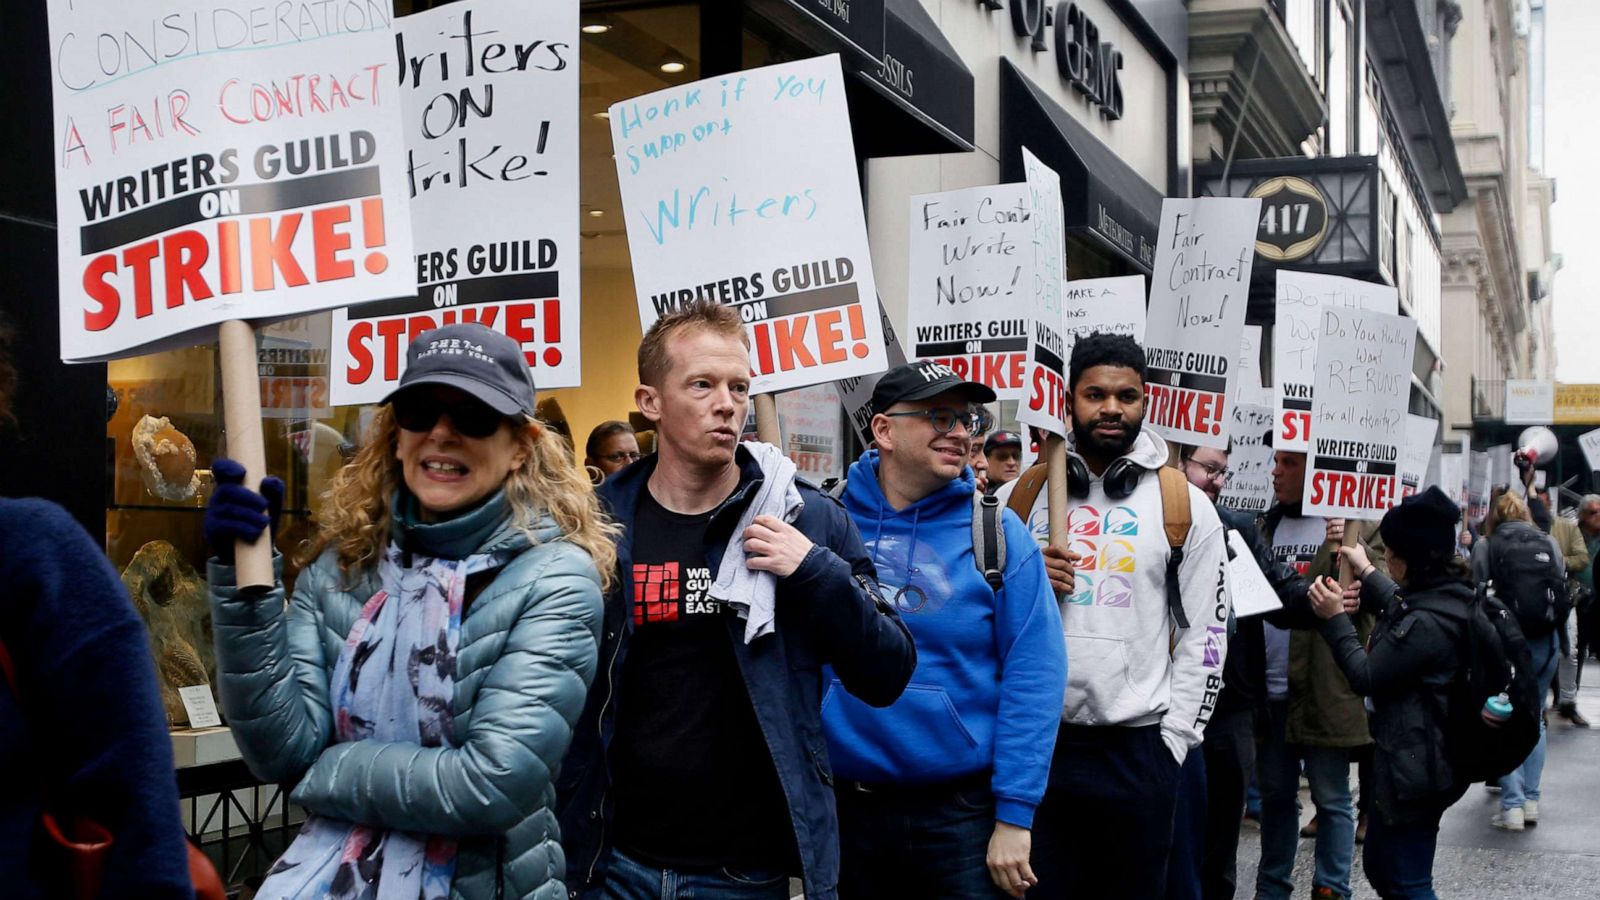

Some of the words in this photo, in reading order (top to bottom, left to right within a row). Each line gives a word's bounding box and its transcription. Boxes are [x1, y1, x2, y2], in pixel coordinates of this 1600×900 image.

[58, 0, 391, 91] CONSIDERATION
[1055, 1, 1124, 121] GEMS
[63, 115, 92, 169] A
[107, 88, 201, 155] FAIR
[218, 63, 388, 125] CONTRACT
[421, 84, 493, 140] ON
[621, 88, 702, 139] Honk
[720, 76, 749, 108] if
[79, 147, 240, 222] WRITERS
[254, 129, 377, 181] GUILD
[406, 120, 550, 199] trike!
[200, 188, 240, 219] ON
[639, 176, 818, 246] Writers
[923, 201, 968, 231] Fair
[1259, 203, 1310, 235] 417
[943, 231, 1016, 266] Write
[1172, 212, 1206, 250] Fair
[82, 196, 389, 332] STRIKE!
[466, 238, 558, 276] GUILD
[1169, 247, 1249, 292] Contract
[433, 283, 458, 308] ON
[650, 271, 765, 319] WRITERS
[771, 256, 855, 294] GUILD
[936, 265, 1022, 306] Now!
[740, 300, 768, 323] ON
[1176, 294, 1229, 329] Now!
[1325, 310, 1346, 338] Do
[1352, 318, 1377, 342] You
[429, 338, 461, 350] THE
[749, 303, 870, 378] IKE!
[916, 321, 983, 343] WRITERS
[988, 317, 1029, 338] GUIL
[966, 340, 983, 354] ON
[417, 348, 439, 360] EAST
[468, 349, 495, 364] YORK
[1146, 347, 1184, 370] WRITERS
[1185, 352, 1229, 376] GUILD
[1170, 372, 1182, 387] ON
[1328, 359, 1402, 397] RERUNS
[1316, 402, 1337, 425] for
[1340, 405, 1355, 425] all
[1316, 437, 1370, 459] WRITERS
[1371, 443, 1398, 462] GUILD
[1356, 460, 1368, 473] ON
[1241, 497, 1267, 509] GUILD
[1310, 470, 1397, 511] STRIKE!
[685, 590, 702, 603] of
[1192, 674, 1221, 730] BELL
